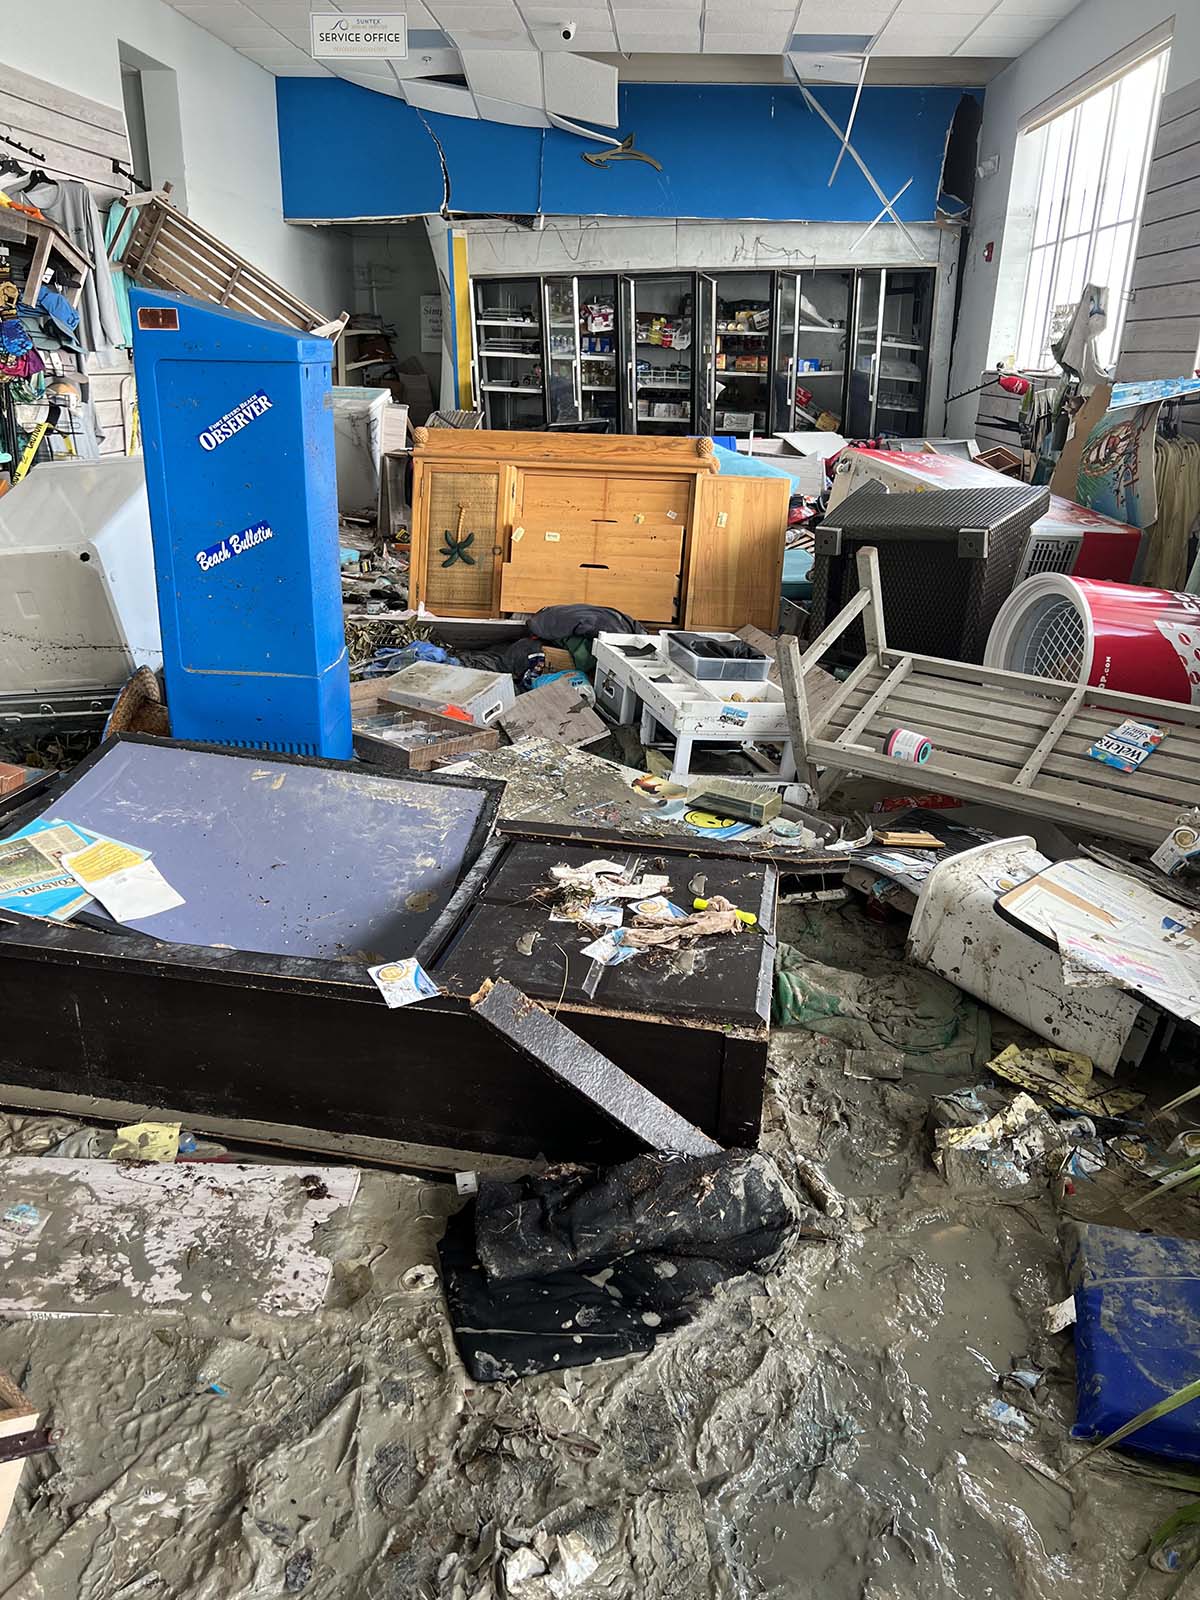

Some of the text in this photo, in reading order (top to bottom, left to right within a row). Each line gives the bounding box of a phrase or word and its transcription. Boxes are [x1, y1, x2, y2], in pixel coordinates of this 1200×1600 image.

[319, 32, 400, 42] SERVICE OFFICE
[199, 395, 273, 451] OBSERVER
[196, 525, 273, 571] Beach Bulletin
[1098, 656, 1112, 688] OP.COM
[1098, 737, 1142, 761] Welch's
[17, 877, 76, 895] COASTAL
